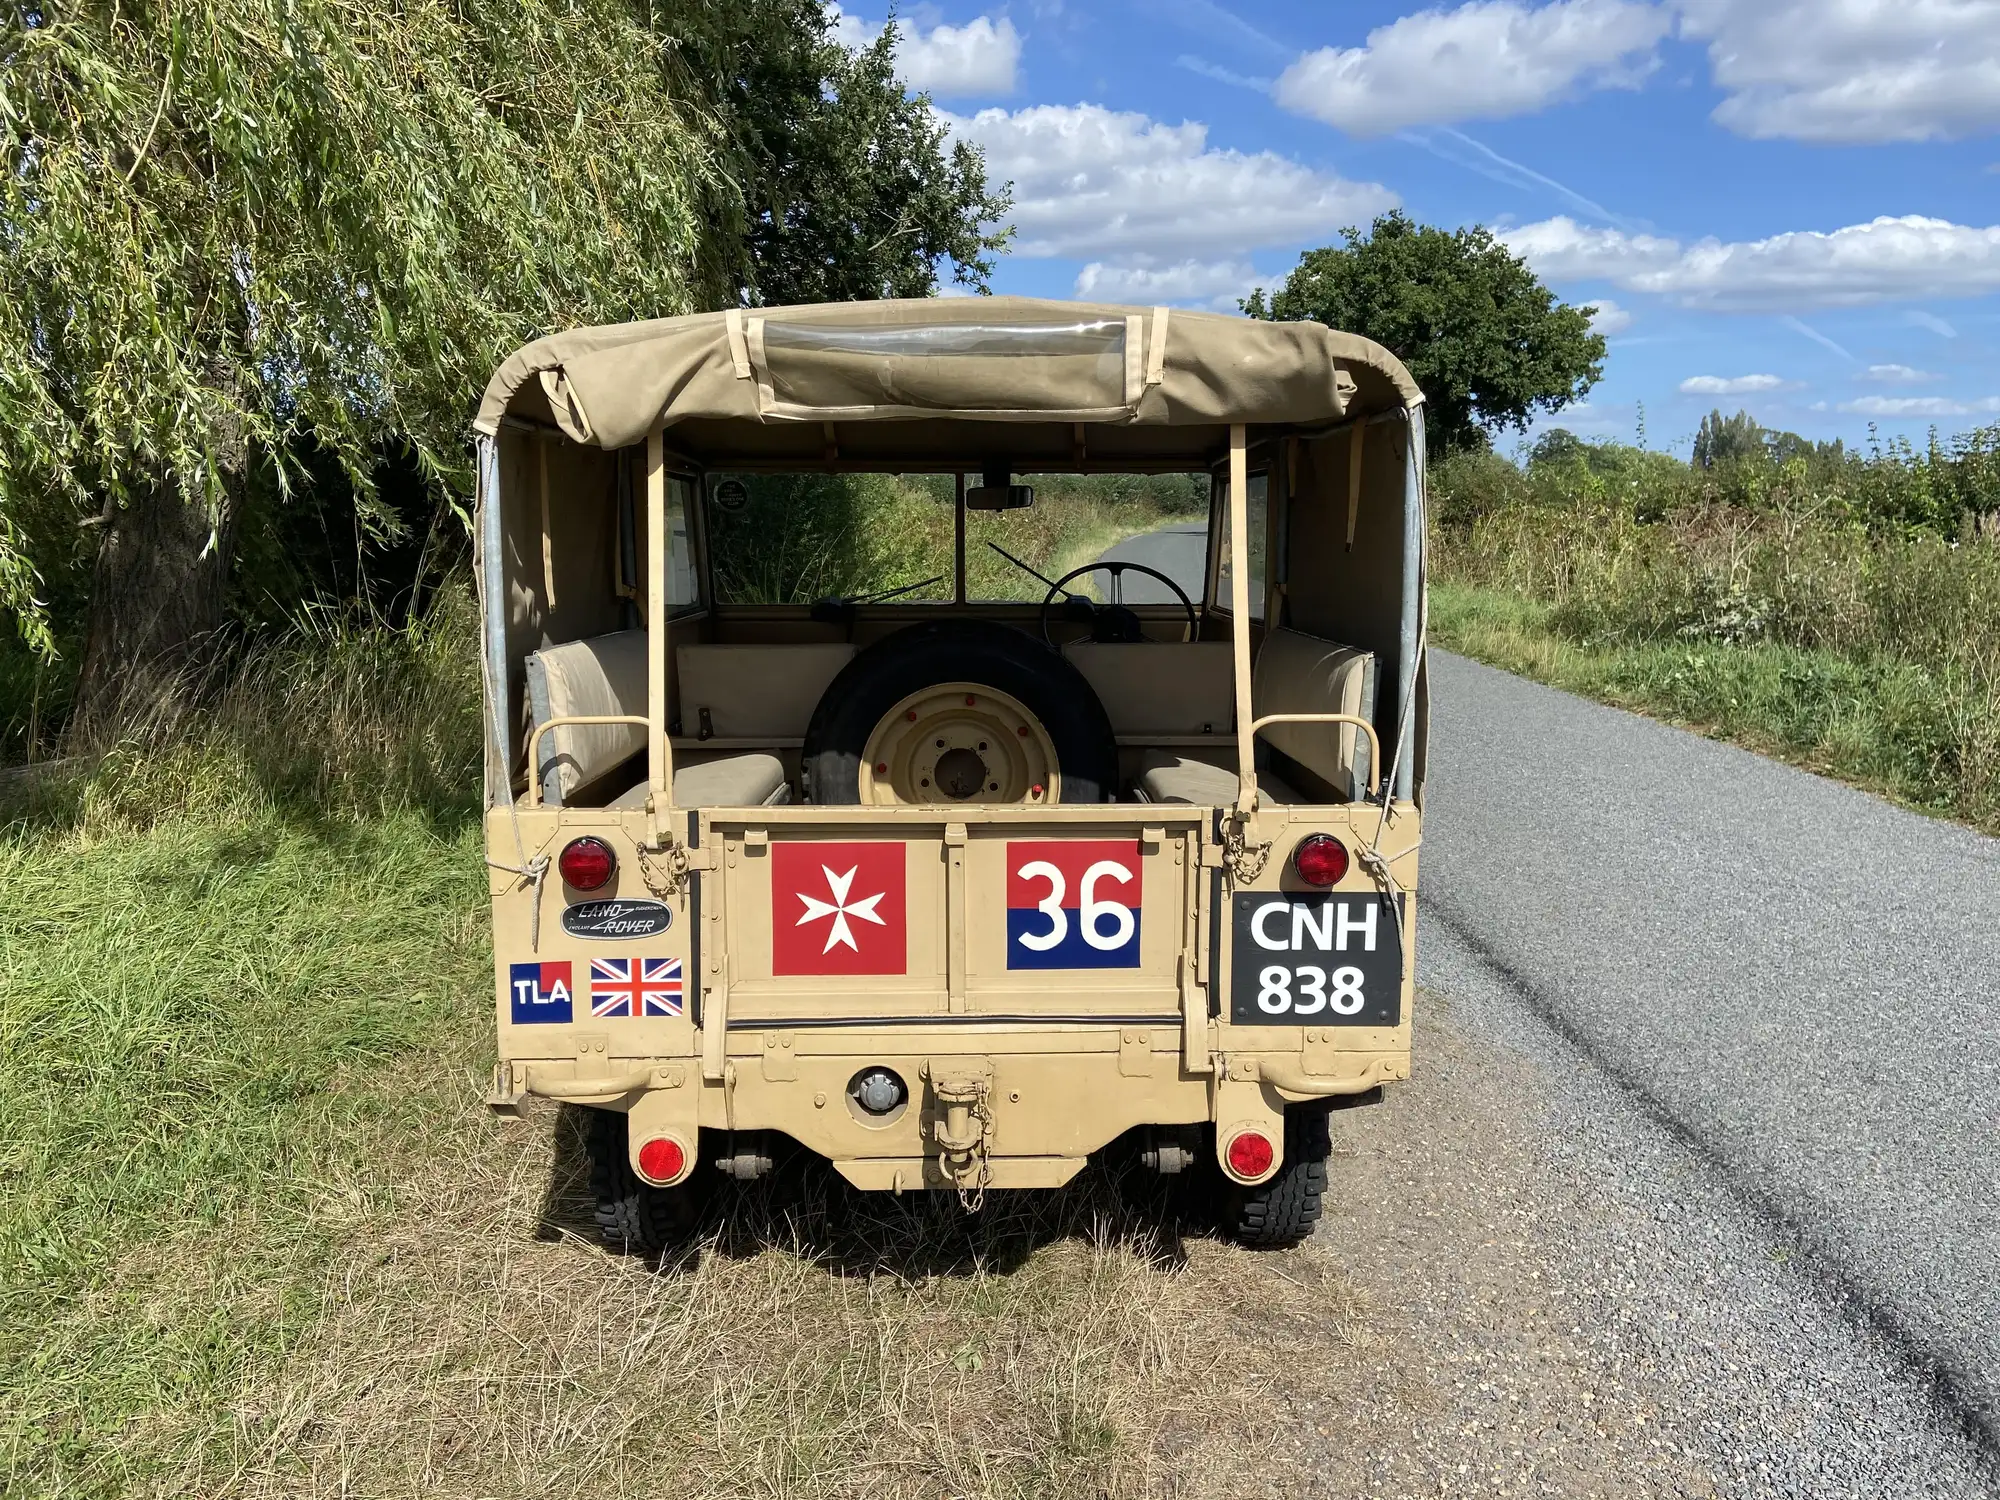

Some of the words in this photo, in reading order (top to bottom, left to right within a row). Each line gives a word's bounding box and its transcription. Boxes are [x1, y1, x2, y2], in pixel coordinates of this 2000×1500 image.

[578, 904, 622, 918] LAND
[1017, 860, 1135, 951] 36
[603, 920, 655, 934] ROVER
[1250, 902, 1378, 951] CNH
[513, 979, 571, 1005] TLA
[1257, 965, 1365, 1015] 838
